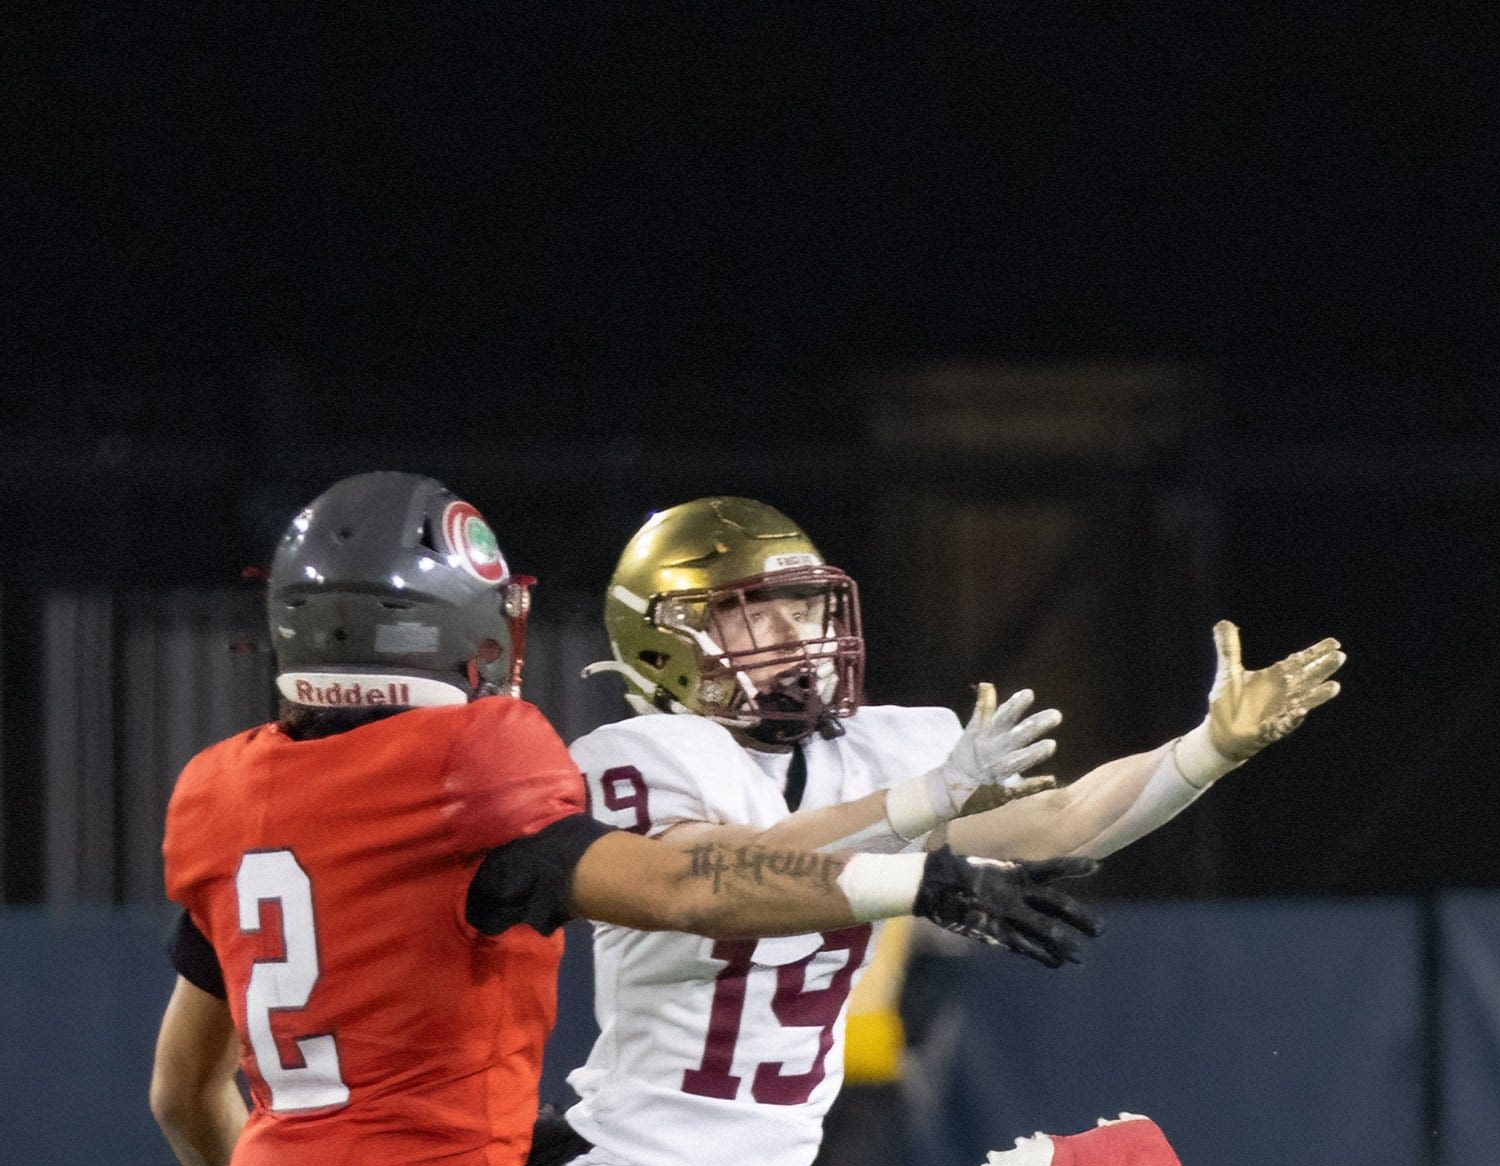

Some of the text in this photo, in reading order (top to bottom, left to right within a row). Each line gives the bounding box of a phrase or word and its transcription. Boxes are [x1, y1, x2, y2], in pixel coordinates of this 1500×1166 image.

[295, 679, 410, 704] Riddell
[584, 765, 652, 836] 9
[235, 848, 350, 1112] 2
[681, 922, 873, 1106] 19
